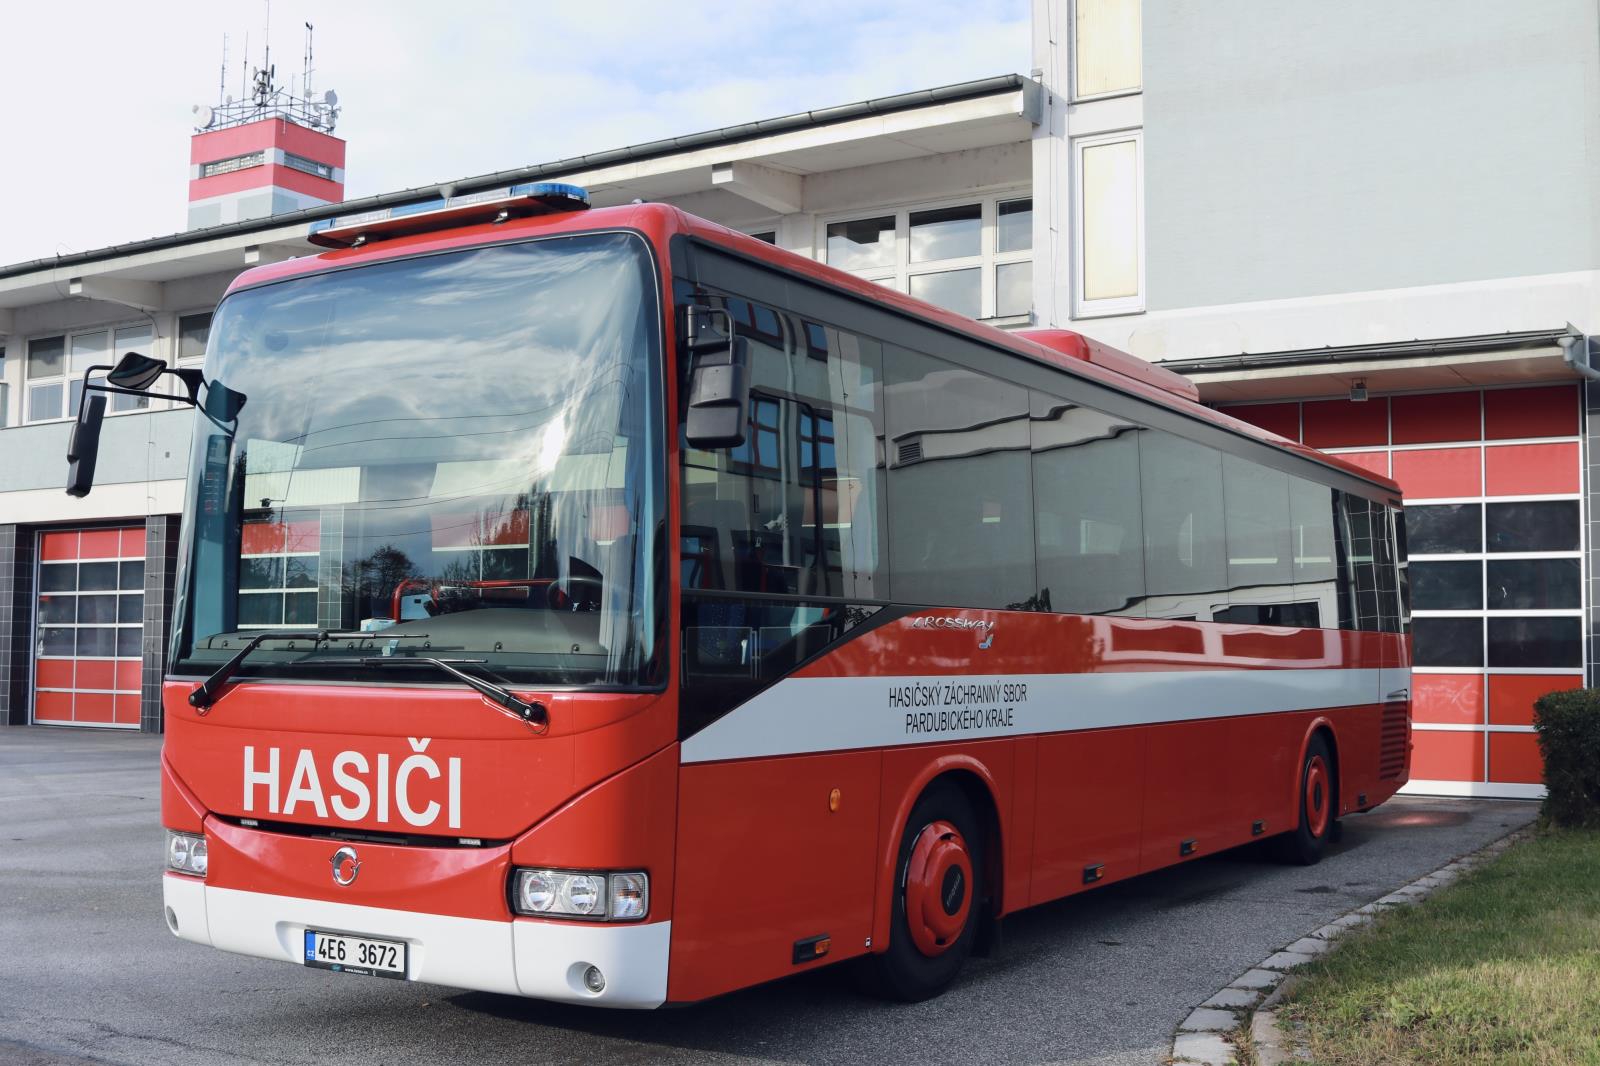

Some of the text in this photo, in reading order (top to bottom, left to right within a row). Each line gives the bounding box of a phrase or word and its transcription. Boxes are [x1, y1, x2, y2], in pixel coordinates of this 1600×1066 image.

[889, 680, 1027, 708] HASIČSKÝ ZÁCHRANNÝ SBOR
[906, 706, 1013, 733] PARDUBICKÉHO KRAJE
[243, 737, 462, 829] HASIČI
[318, 937, 397, 969] 4E6 3672
